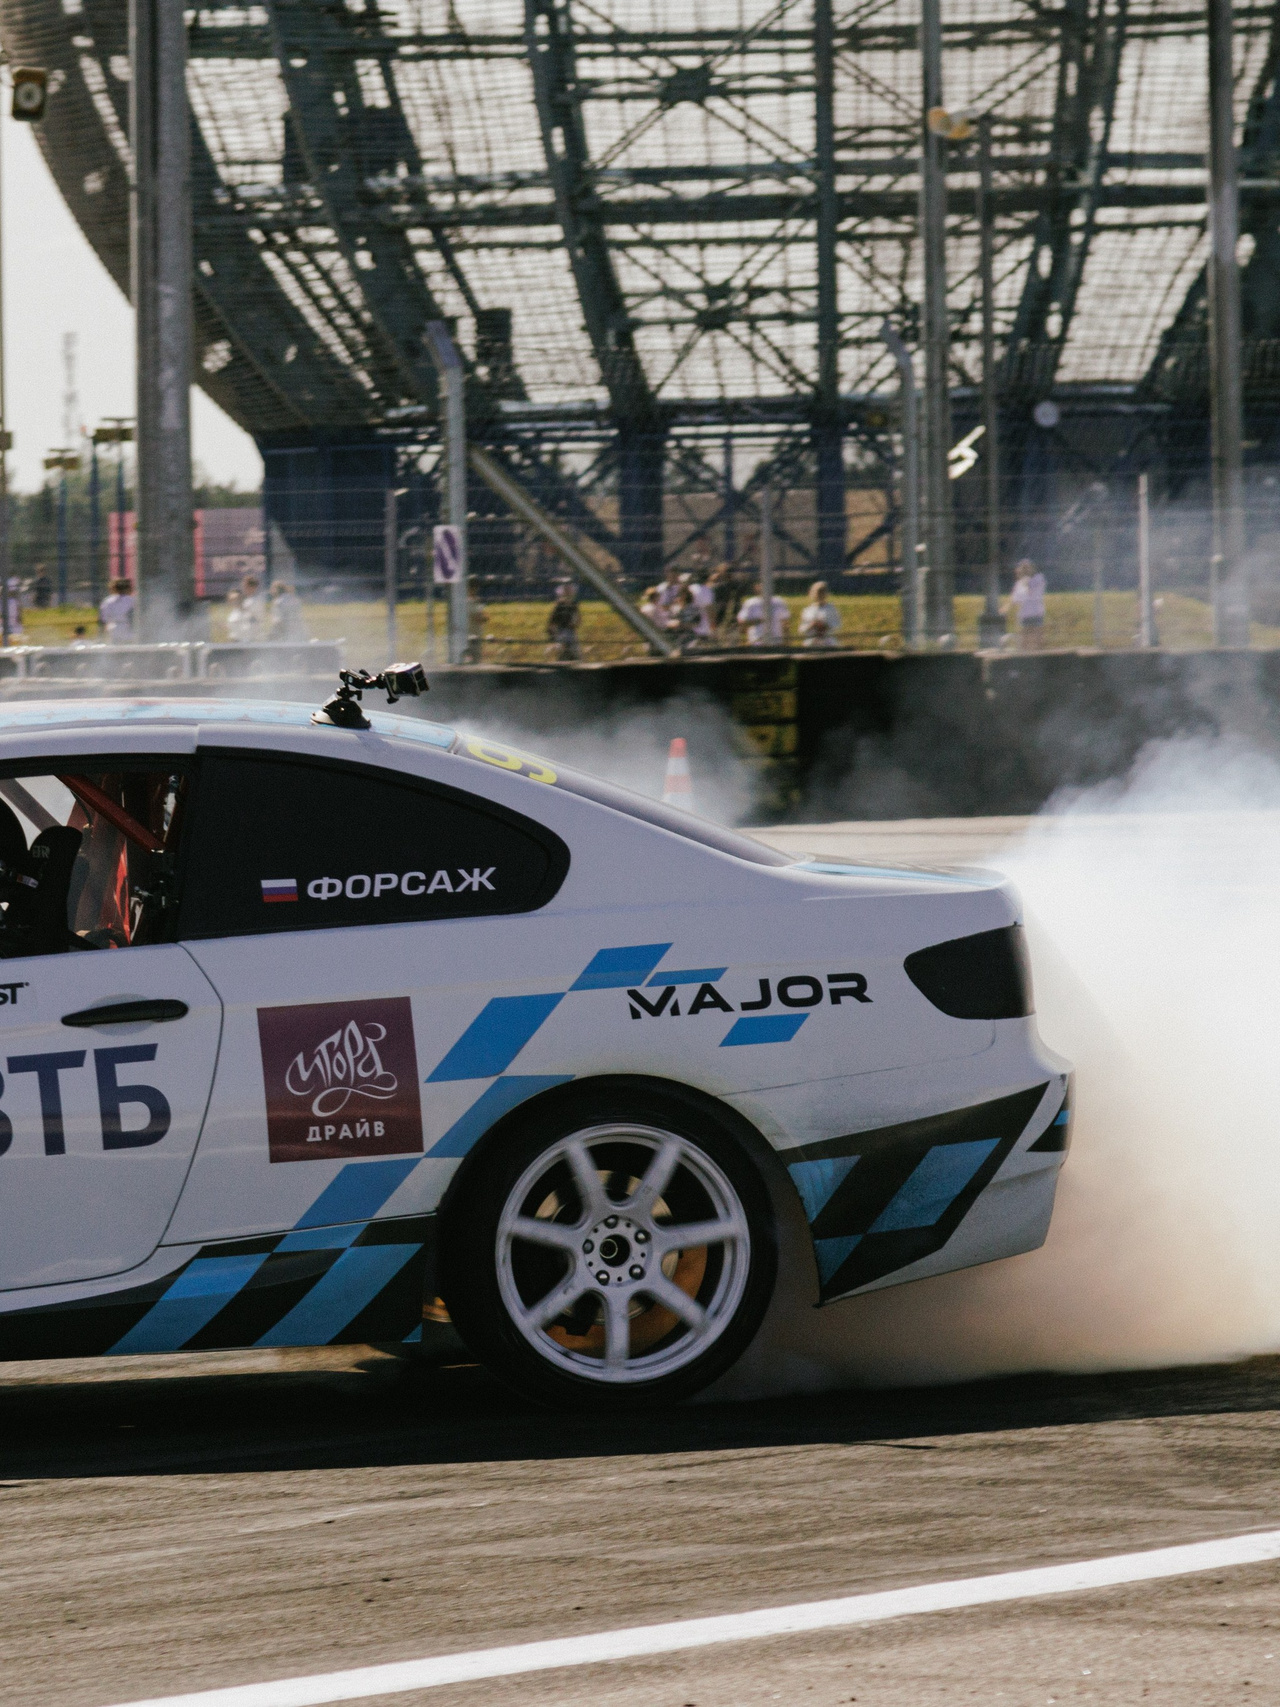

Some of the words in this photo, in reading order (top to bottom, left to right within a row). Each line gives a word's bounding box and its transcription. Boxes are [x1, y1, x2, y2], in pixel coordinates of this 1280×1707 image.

[307, 867, 497, 900] ФОРСАЖ
[627, 973, 874, 1020] MAJOR
[306, 1118, 386, 1142] ДРАЙВ
